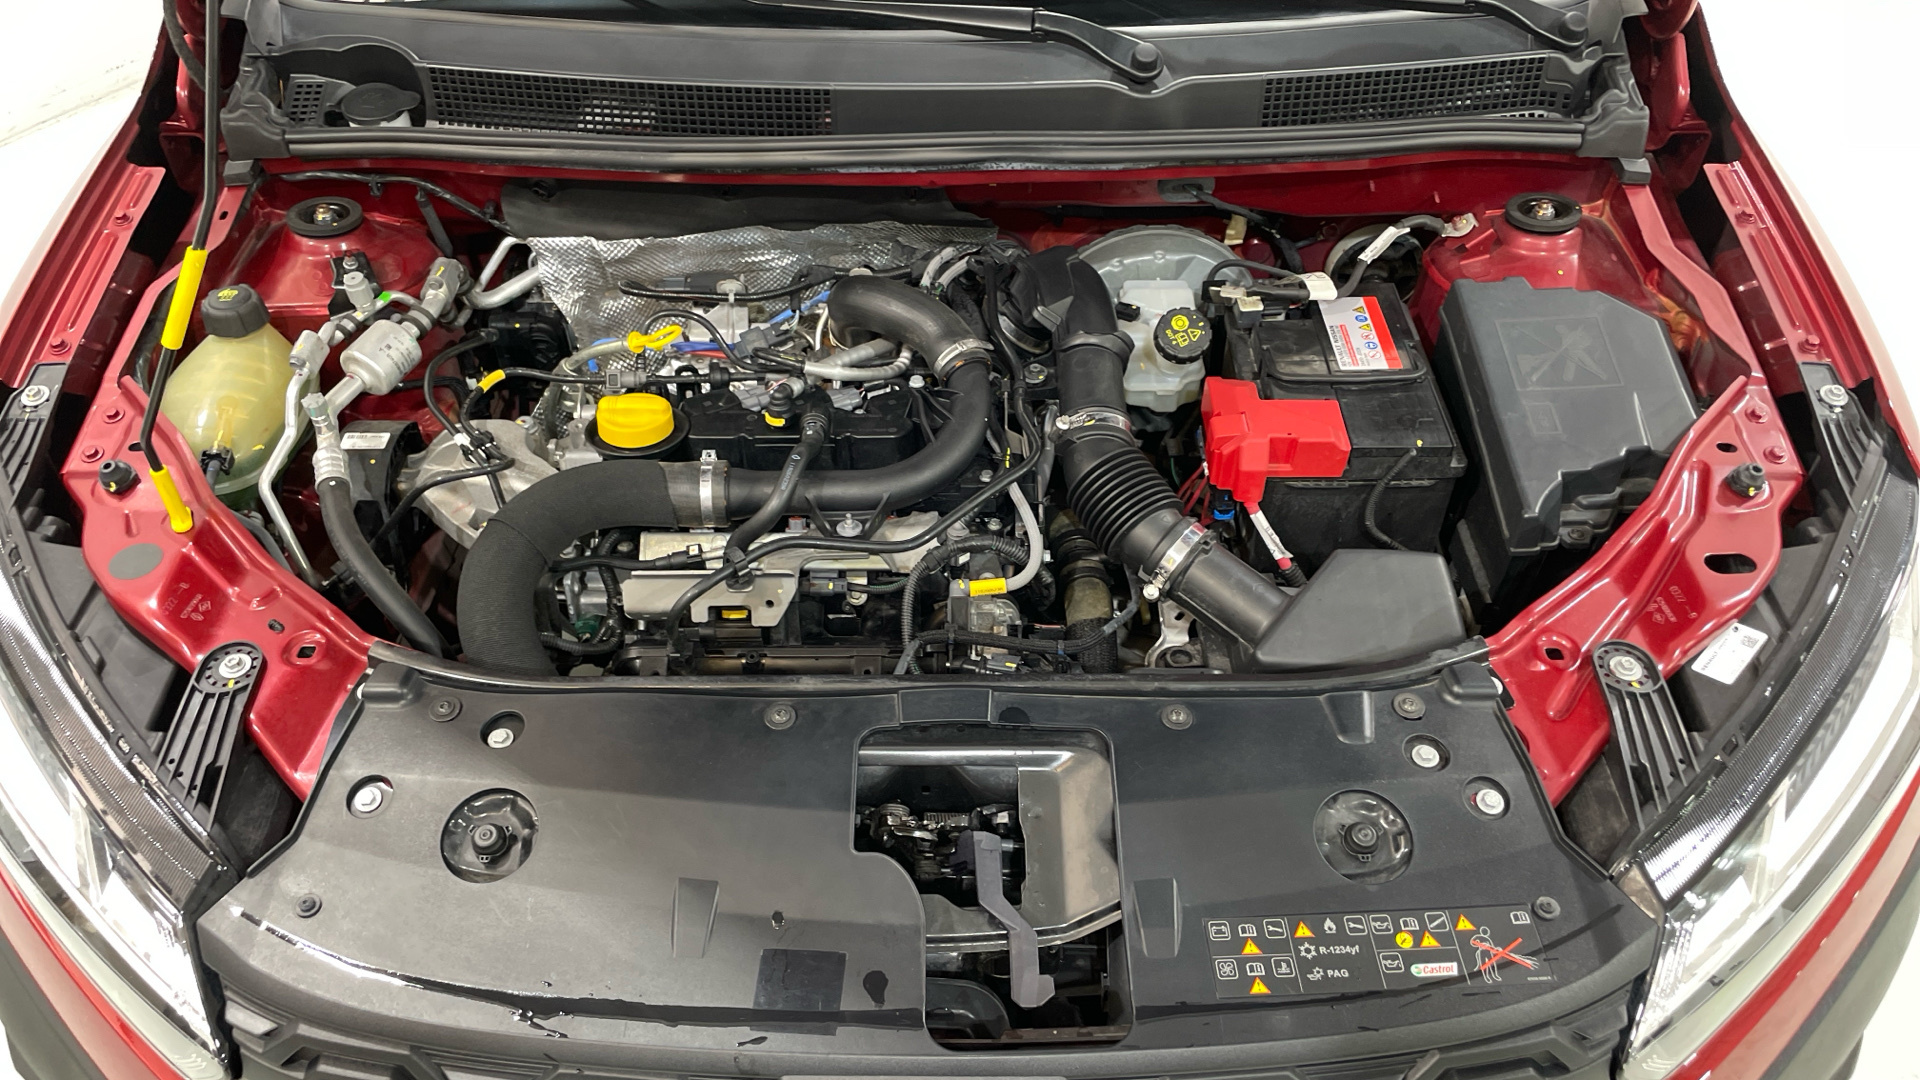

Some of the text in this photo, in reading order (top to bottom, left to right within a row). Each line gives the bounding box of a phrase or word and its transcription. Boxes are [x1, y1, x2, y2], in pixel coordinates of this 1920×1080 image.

[1329, 325, 1338, 344] NISSAN
[1334, 345, 1347, 367] RENAULT
[1318, 944, 1360, 955] R-1234yf
[1326, 969, 1350, 978] PAG
[1422, 964, 1455, 975] Castrol
